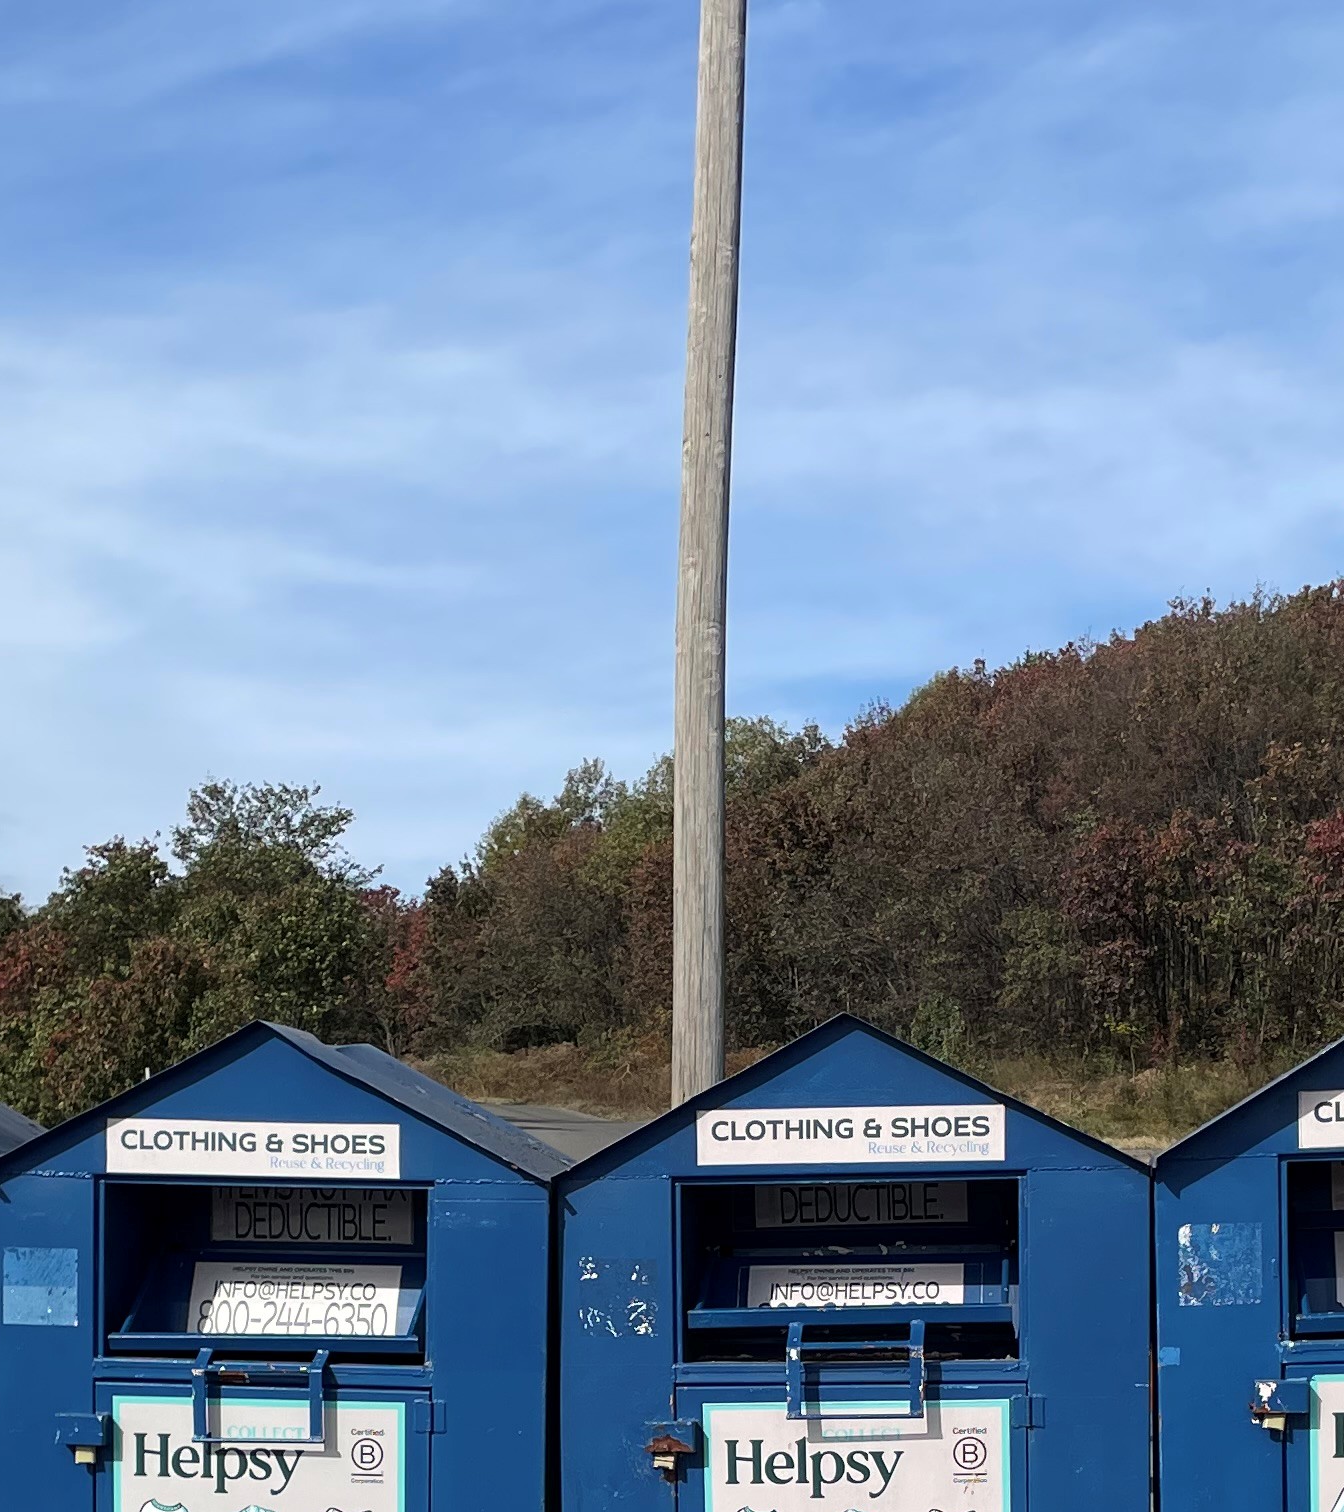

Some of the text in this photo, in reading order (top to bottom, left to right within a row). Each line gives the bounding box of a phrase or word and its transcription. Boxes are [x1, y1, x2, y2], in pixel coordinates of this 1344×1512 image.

[711, 1116, 990, 1141] CLOTHING & SHOES
[120, 1129, 386, 1155] CLOTHING & SHOES
[868, 1140, 990, 1156] Reuse & Recycling
[270, 1156, 385, 1173] Reuse & Recycling
[780, 1183, 944, 1224] DEDUCTIBLE.
[234, 1202, 392, 1241] DEDUCTIBLE.
[213, 1280, 376, 1301] INFO@HELPSY.CO
[770, 1281, 940, 1302] INFO@HELPSY.CO
[197, 1299, 388, 1336] 800-244-6350
[227, 1425, 305, 1439] COLLECT
[351, 1429, 384, 1437] Certified
[824, 1427, 904, 1441] COLLECT
[952, 1427, 987, 1435] Certified
[134, 1432, 304, 1495] Helpsy
[360, 1445, 375, 1463] B
[962, 1443, 978, 1463] B
[725, 1437, 904, 1499] Helpsy
